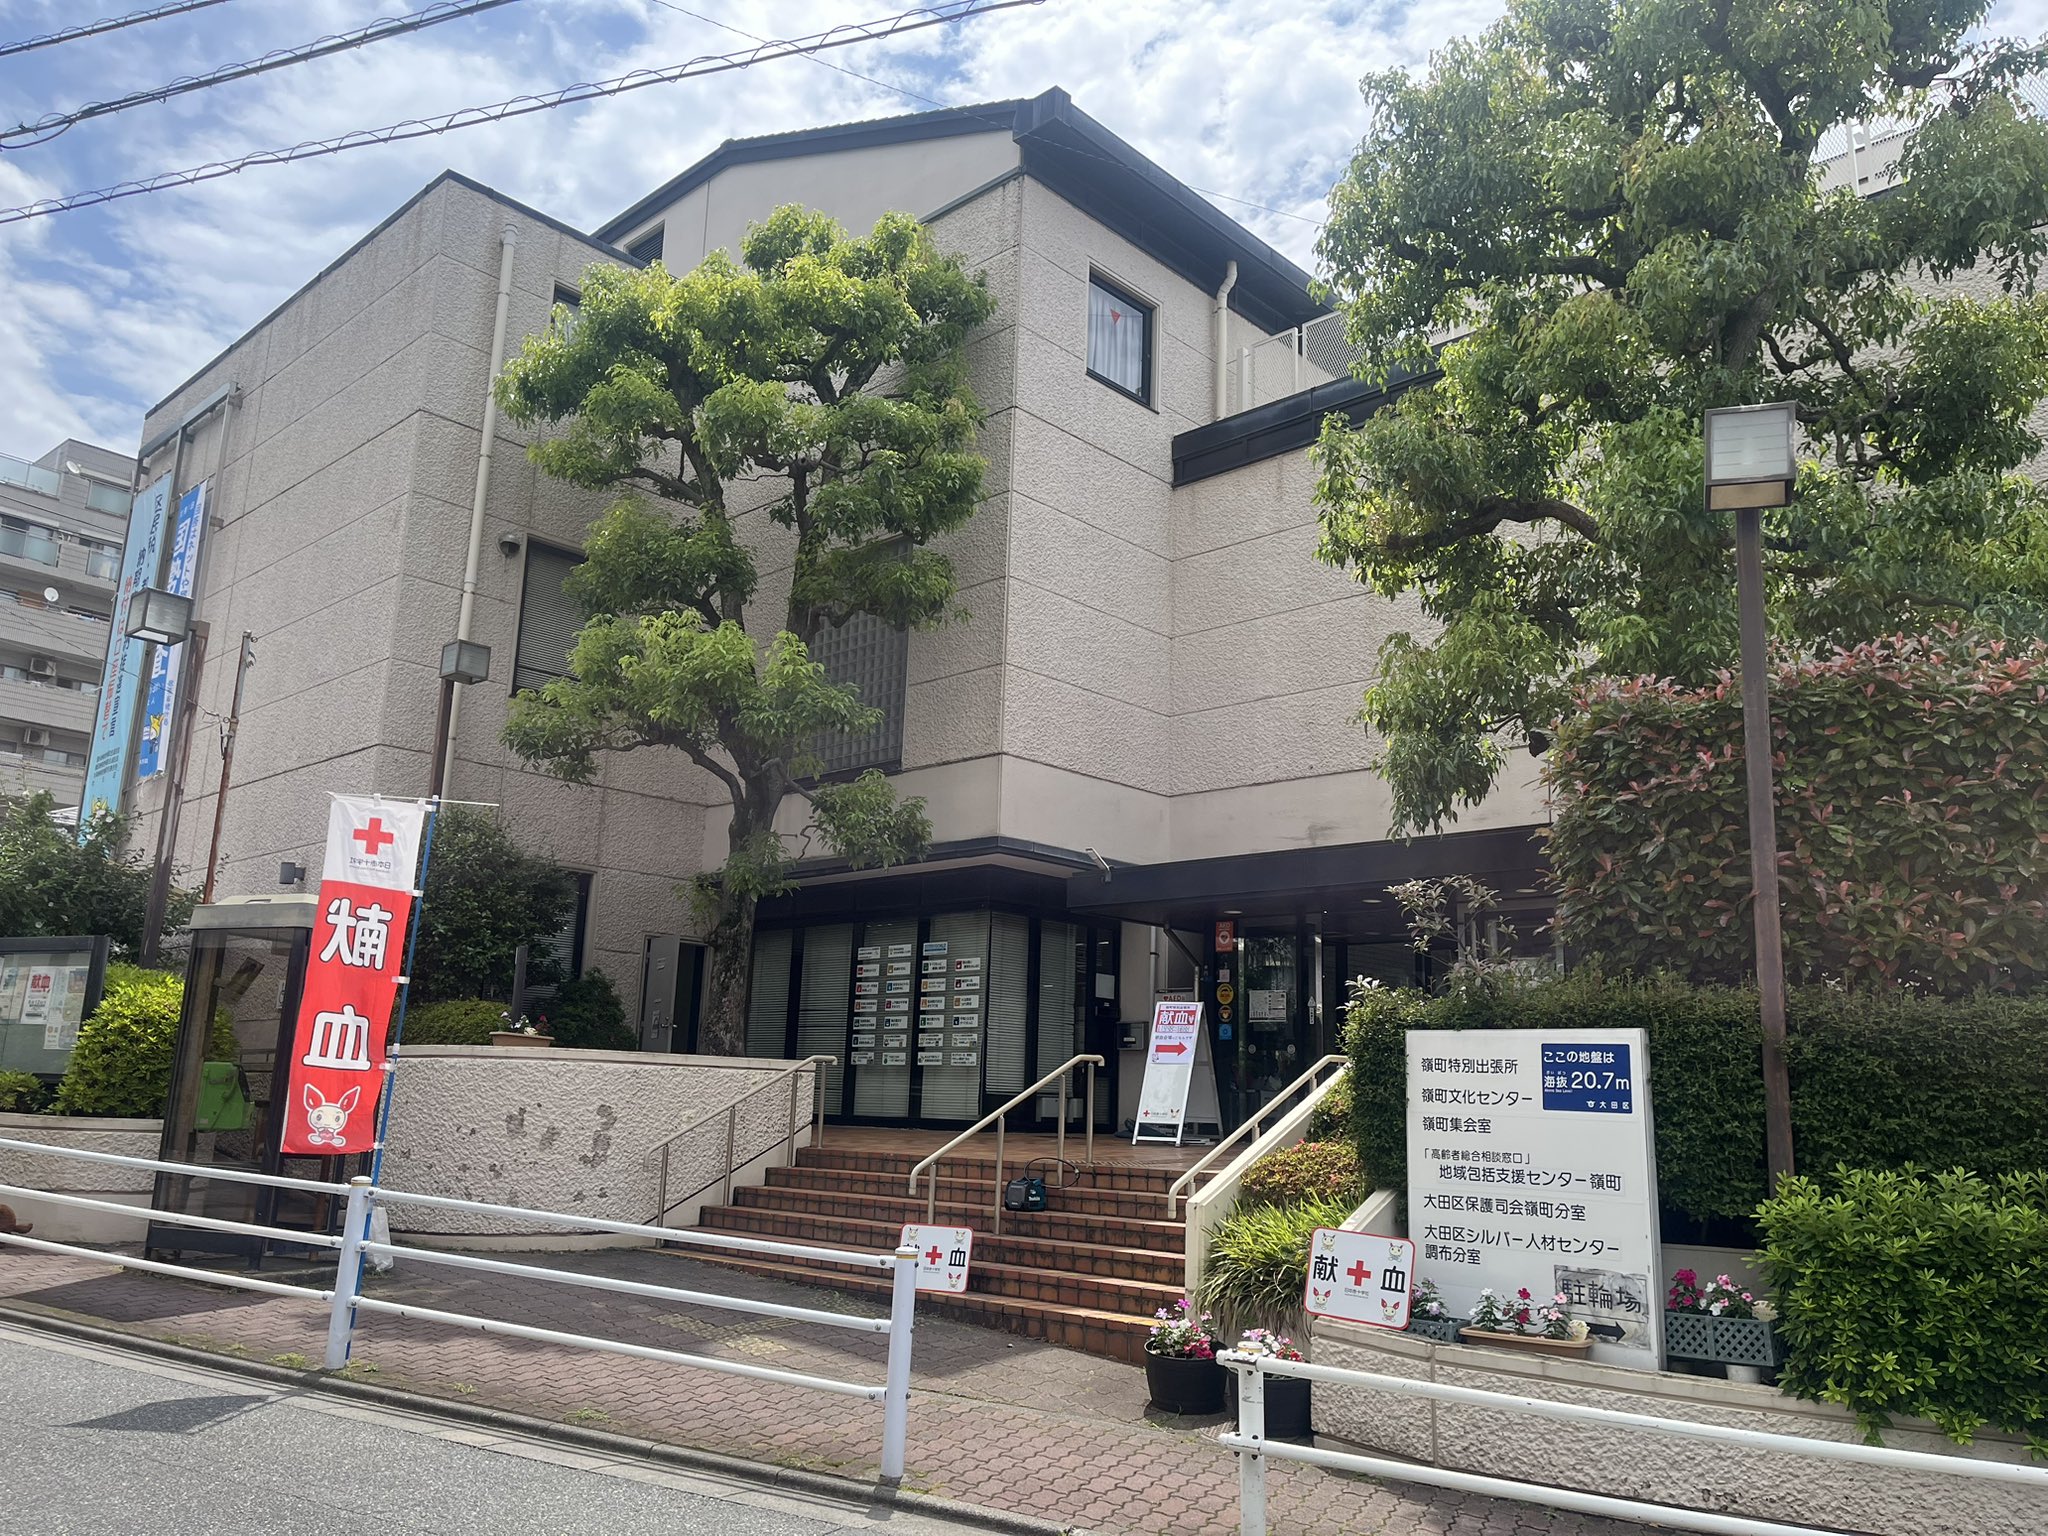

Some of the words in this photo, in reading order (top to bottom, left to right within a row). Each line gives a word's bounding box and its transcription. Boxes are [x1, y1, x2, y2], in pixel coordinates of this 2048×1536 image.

[1159, 1010, 1188, 1025] 献血
[1421, 1057, 1518, 1074] 嶺町特別出張所
[1543, 1051, 1615, 1064] ここの地盤は
[1544, 1075, 1568, 1088] 海抜
[1571, 1071, 1630, 1090] 20.7m
[1421, 1088, 1533, 1106] 嶺町文化センター
[1599, 1101, 1630, 1110] 大田区
[1422, 1116, 1491, 1134] 嶺町集会室
[1424, 1148, 1531, 1165] 「高齢者総合相談窓口」
[1439, 1164, 1622, 1192] 地域包括支援センター嶺町
[1423, 1193, 1587, 1222] 大田区保護司会嶺町分室
[1424, 1224, 1620, 1256] 大田区シルバー人材センター
[948, 1247, 967, 1268] 血
[1425, 1243, 1481, 1265] 調布分室
[1312, 1254, 1339, 1283] 献
[1380, 1265, 1406, 1294] 血
[1561, 1279, 1641, 1314] 駐輪場
